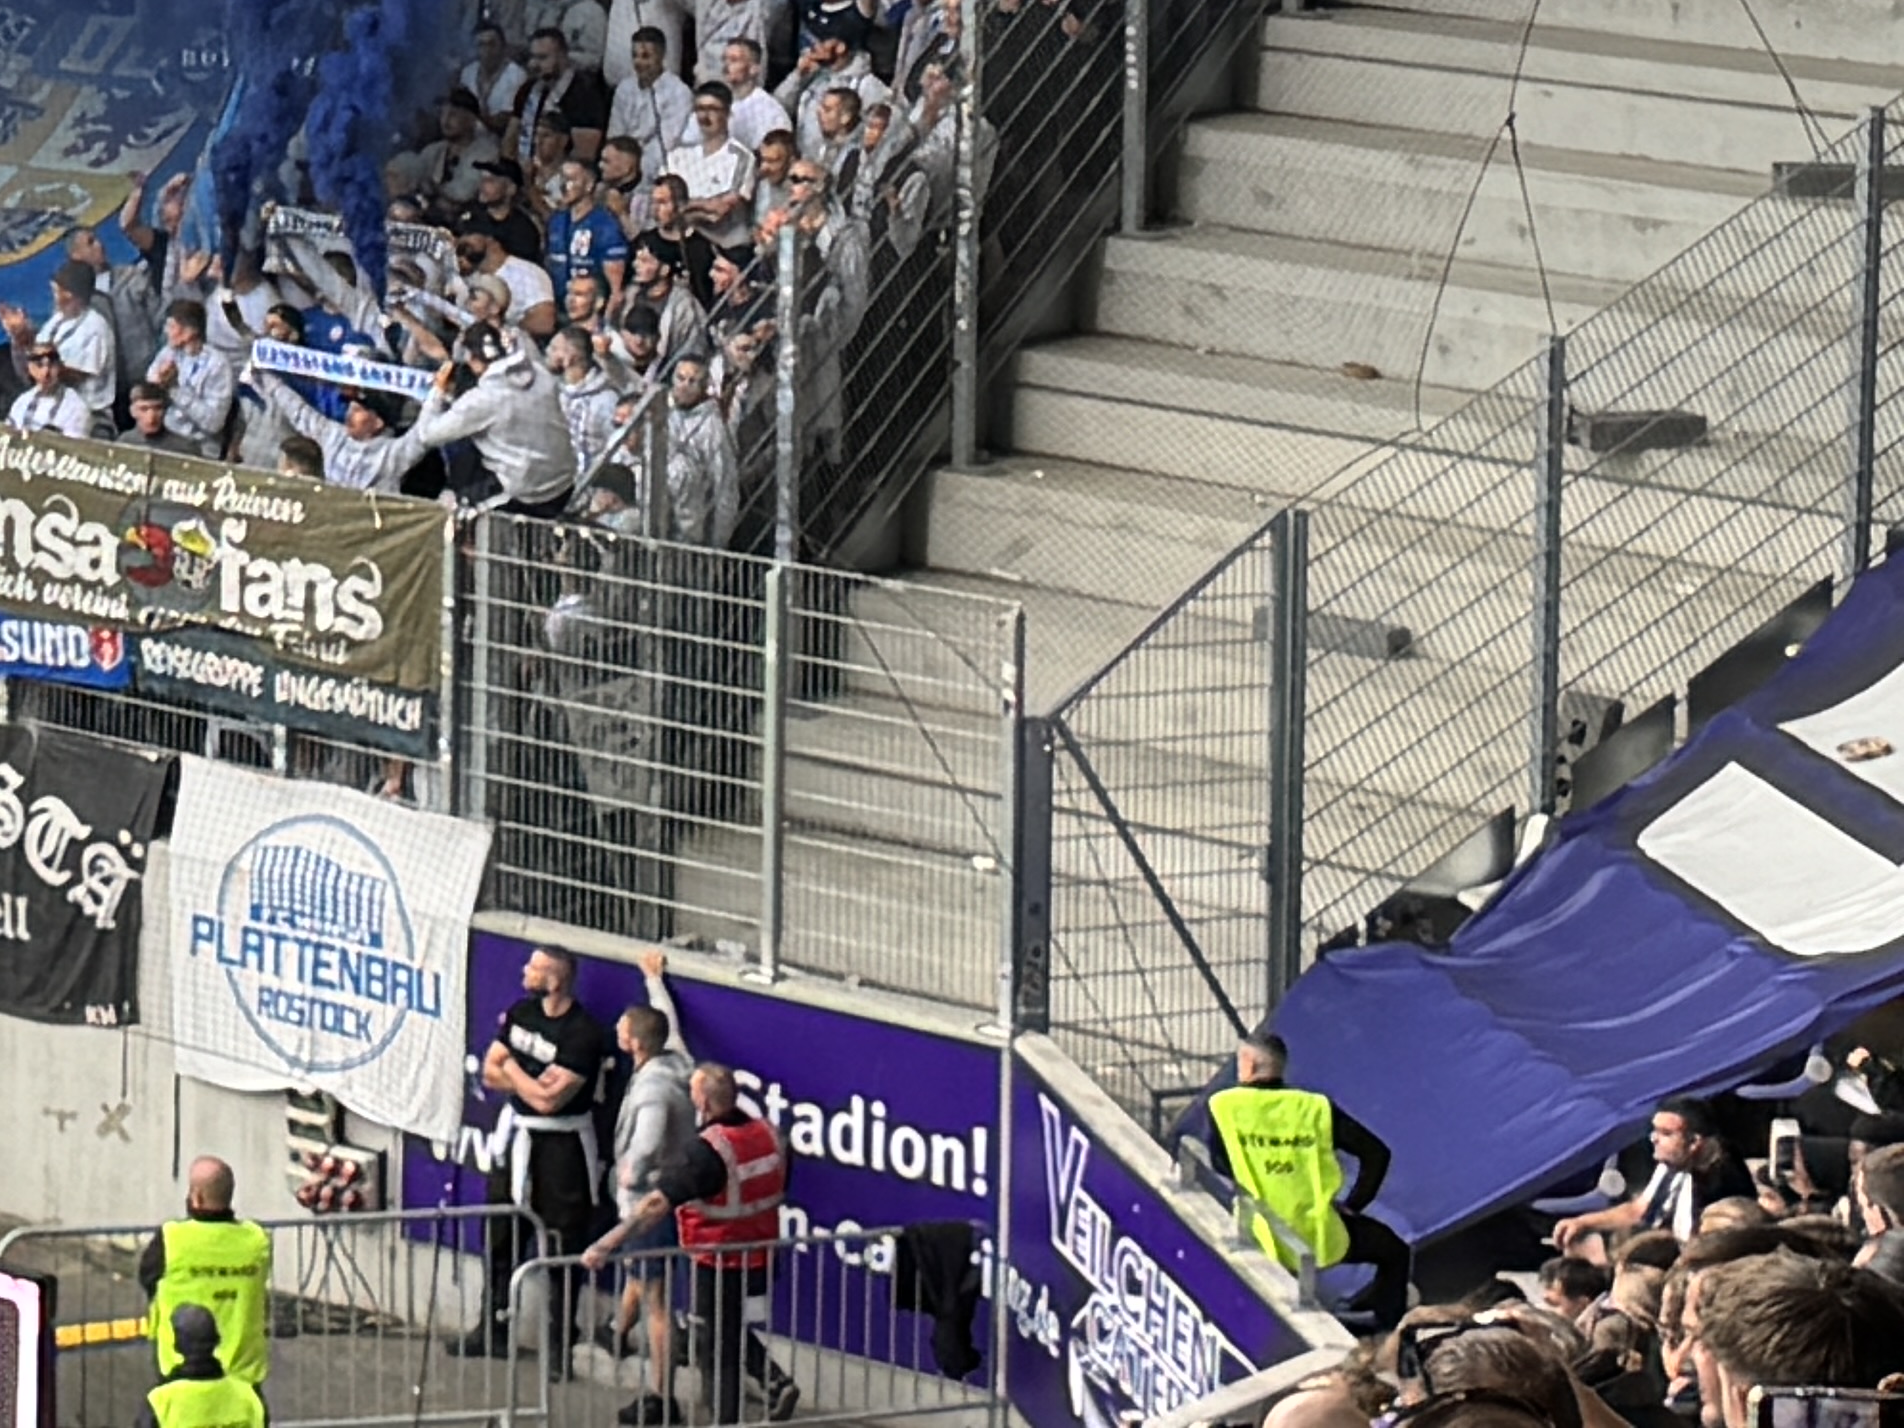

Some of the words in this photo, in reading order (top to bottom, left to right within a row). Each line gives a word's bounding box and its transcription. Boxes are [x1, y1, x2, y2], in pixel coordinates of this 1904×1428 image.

[219, 517, 385, 642] fans
[188, 913, 442, 1020] PLATTENBAU
[256, 985, 373, 1044] ROSTOCK
[732, 1069, 989, 1197] Stadion!
